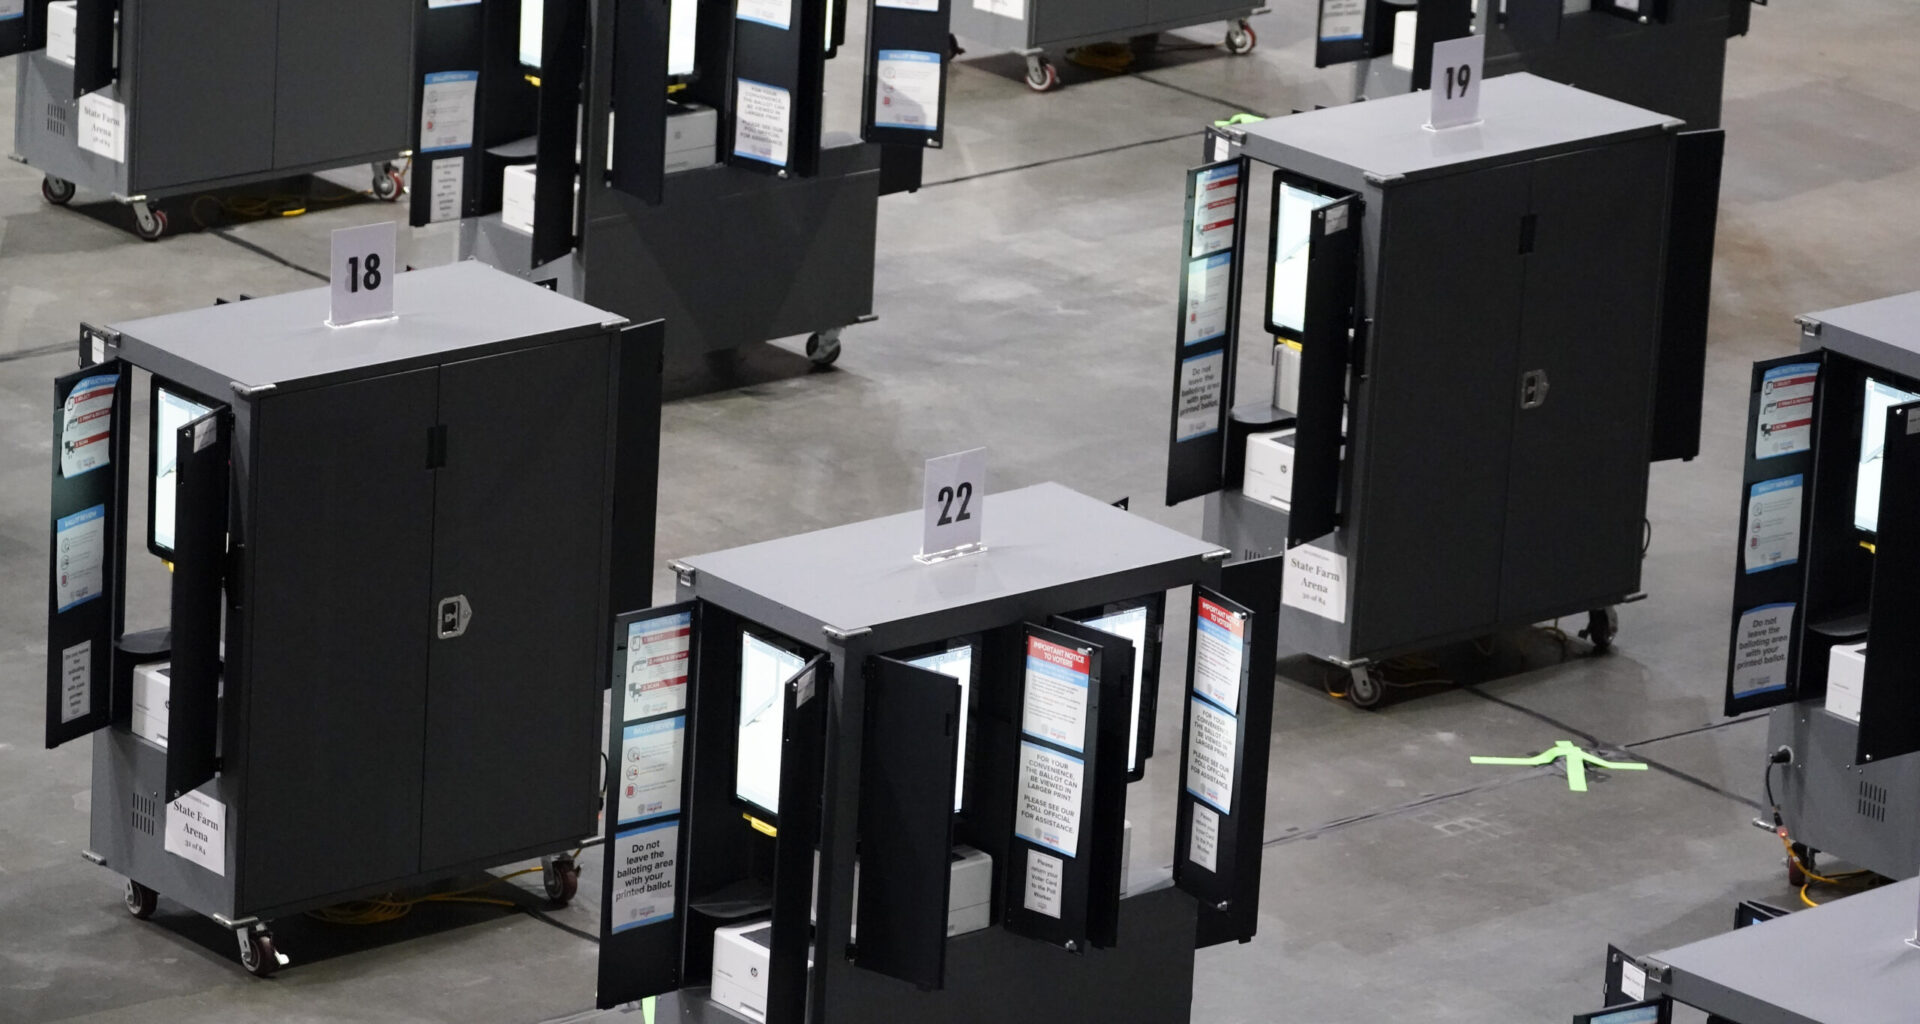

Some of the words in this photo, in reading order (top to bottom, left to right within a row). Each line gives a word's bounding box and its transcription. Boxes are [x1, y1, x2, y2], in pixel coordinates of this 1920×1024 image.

[1446, 64, 1471, 100] 19
[349, 253, 381, 293] 18
[937, 482, 972, 526] 22
[1291, 558, 1313, 573] State
[1316, 566, 1340, 582] Farm
[1301, 577, 1328, 593] Arena
[1202, 602, 1225, 619] IMPORTANT
[1217, 617, 1232, 630] VOTERS
[1753, 620, 1763, 628] Do
[1764, 617, 1777, 625] not
[1034, 642, 1064, 656] IMPORTANT
[1065, 650, 1085, 663] NOTICE
[1044, 652, 1053, 661] TO
[1053, 655, 1073, 668] VOTERS
[1203, 710, 1212, 719] FOR
[1214, 716, 1225, 725] YOUR
[1196, 738, 1213, 751] LARGER
[1037, 754, 1049, 763] FOR
[1052, 758, 1068, 769] YOUR
[1191, 766, 1200, 774] FOR
[1193, 750, 1209, 763] PLEASE
[1219, 763, 1229, 772] OUR
[1195, 758, 1206, 769] POLL
[1207, 765, 1226, 780] OFFICIAL
[1026, 766, 1037, 775] THE
[1039, 770, 1062, 782] BALLOT
[1064, 779, 1077, 788] CAN
[1040, 778, 1063, 791] VIEWED
[1028, 783, 1051, 795] LARGER
[1024, 794, 1046, 807] PLEASE
[1048, 803, 1059, 811] SEE
[1061, 808, 1075, 816] OUR
[1027, 804, 1041, 814] POLL
[1044, 810, 1070, 823] OFFICIAL
[174, 800, 195, 818] State
[198, 811, 218, 831] Farm
[1022, 811, 1033, 819] FOR
[1036, 815, 1074, 834] ASSISTANCE.
[184, 822, 208, 842] Arena
[632, 844, 644, 853] Do
[646, 840, 660, 850] not
[627, 854, 648, 864] leave
[651, 851, 664, 860] the
[617, 864, 652, 878] balloting
[655, 860, 673, 869] area
[625, 876, 642, 887] with
[645, 872, 664, 884] your
[616, 886, 644, 902] printed
[647, 881, 672, 892] ballot.
